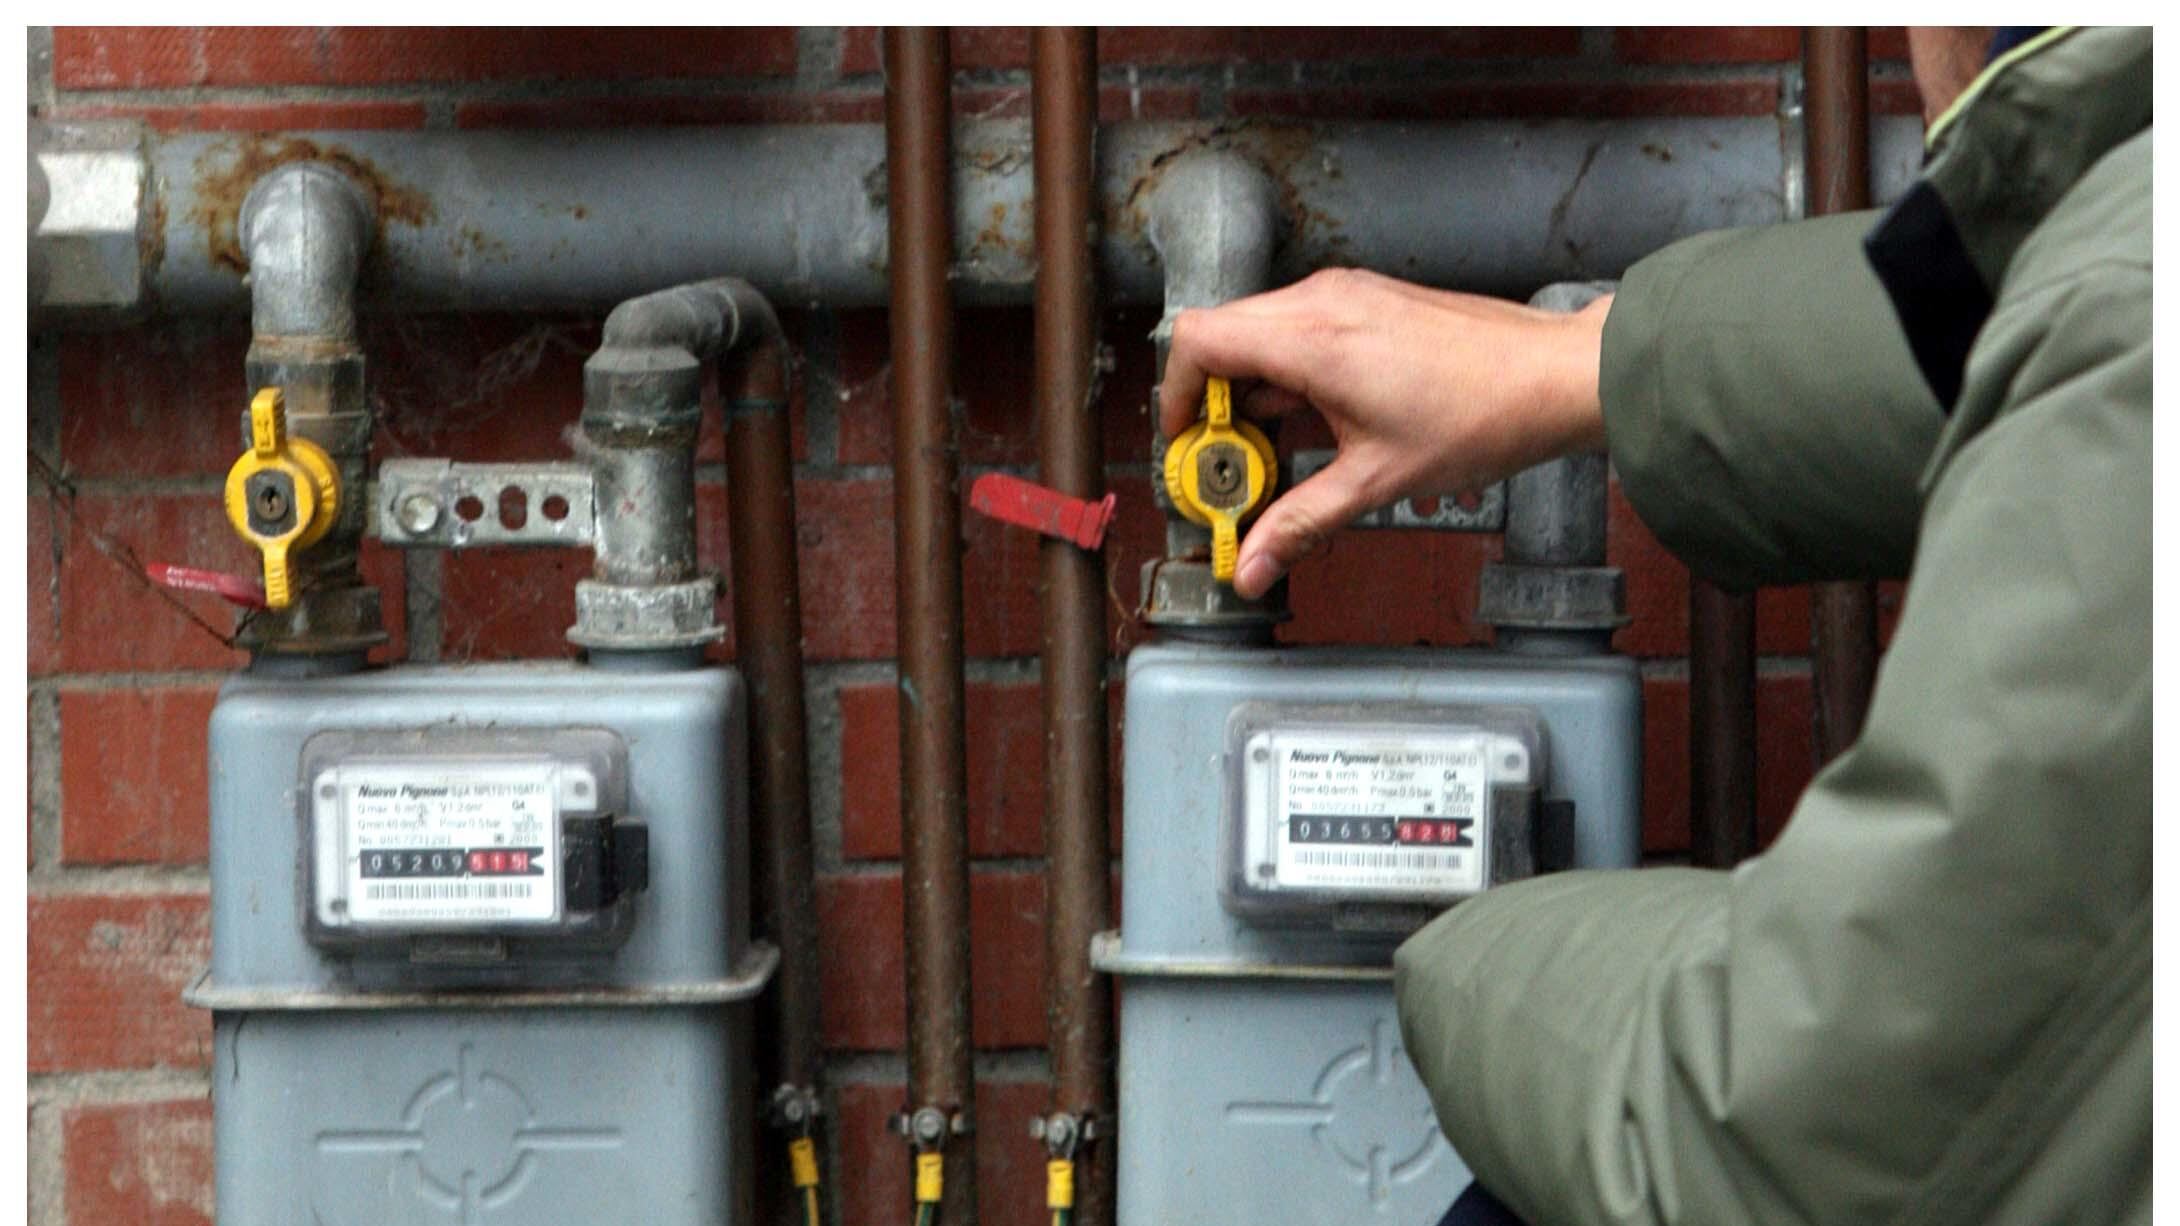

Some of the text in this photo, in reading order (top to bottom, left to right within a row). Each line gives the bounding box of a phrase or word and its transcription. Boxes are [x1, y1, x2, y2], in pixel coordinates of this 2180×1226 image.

[1289, 748, 1330, 763] Nuovo
[1332, 750, 1380, 766] Pignone
[358, 784, 398, 798] Nuovo
[400, 784, 448, 800] Pignone
